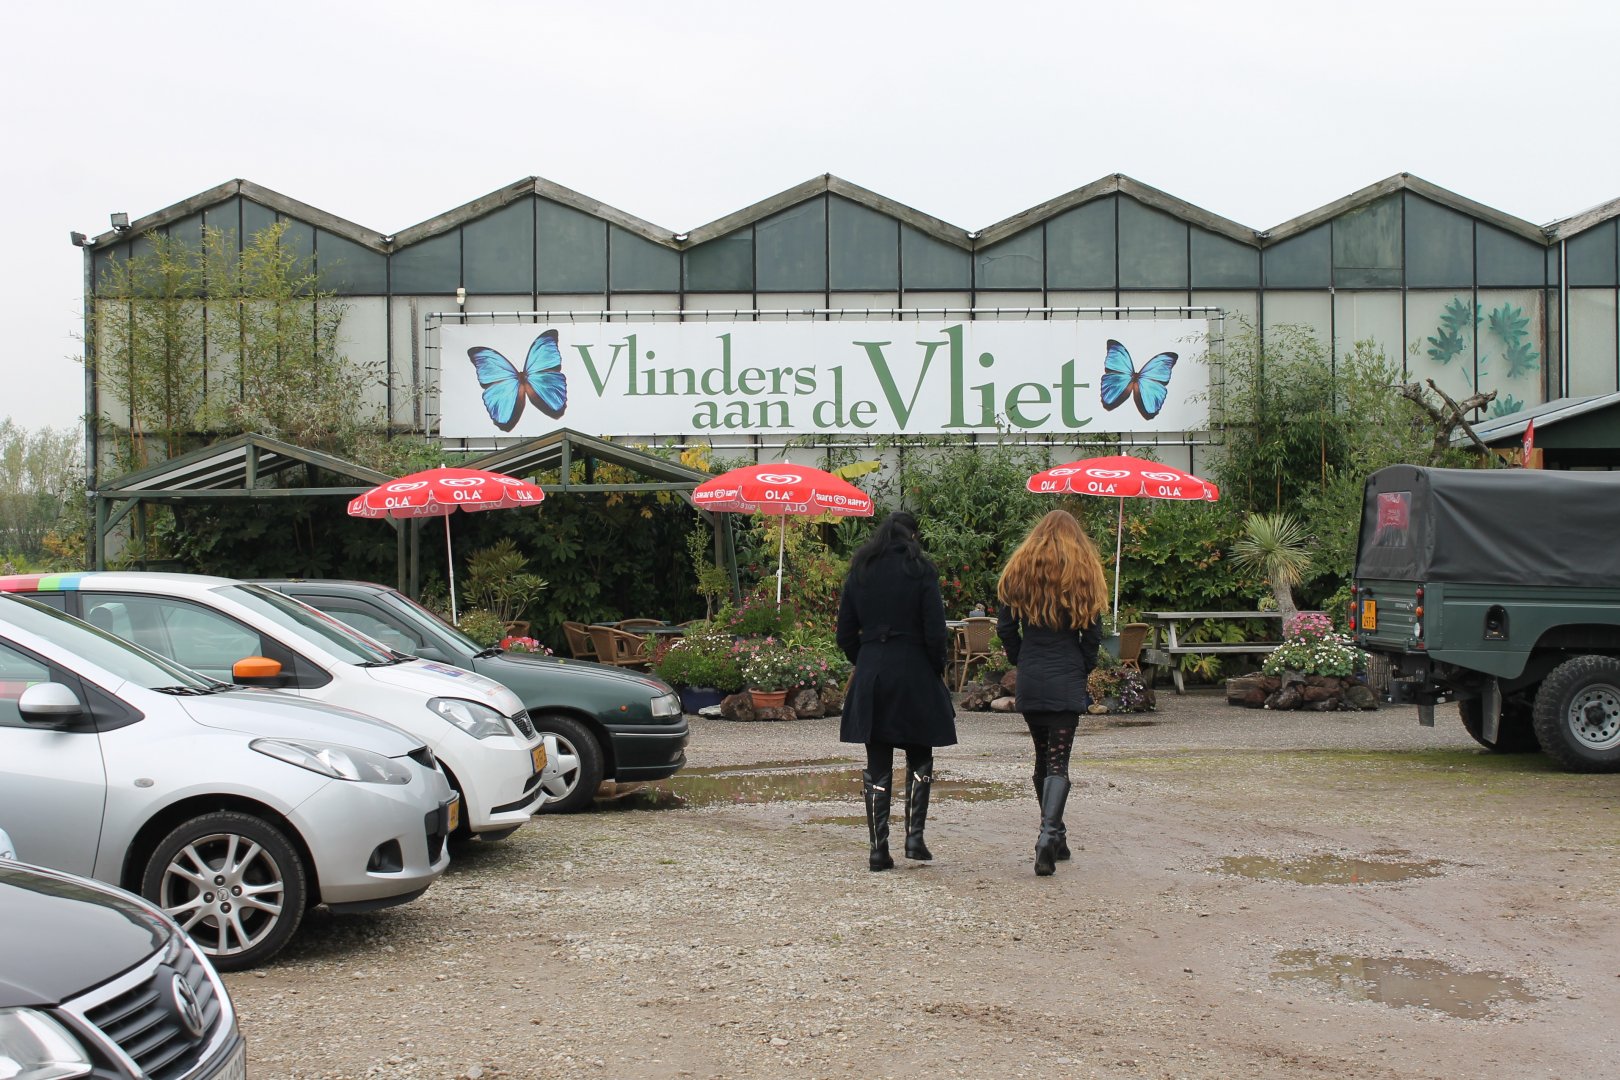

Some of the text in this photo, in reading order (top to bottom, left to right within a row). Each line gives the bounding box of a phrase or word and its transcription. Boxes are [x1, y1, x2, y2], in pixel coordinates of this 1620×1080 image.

[571, 333, 816, 397] Vlinders
[692, 324, 1093, 430] aan de Vliet
[1088, 482, 1115, 493] OLA
[1159, 486, 1181, 496] OLA
[453, 490, 481, 501] OLA
[765, 490, 790, 500] OLA
[385, 496, 409, 507] OLA
